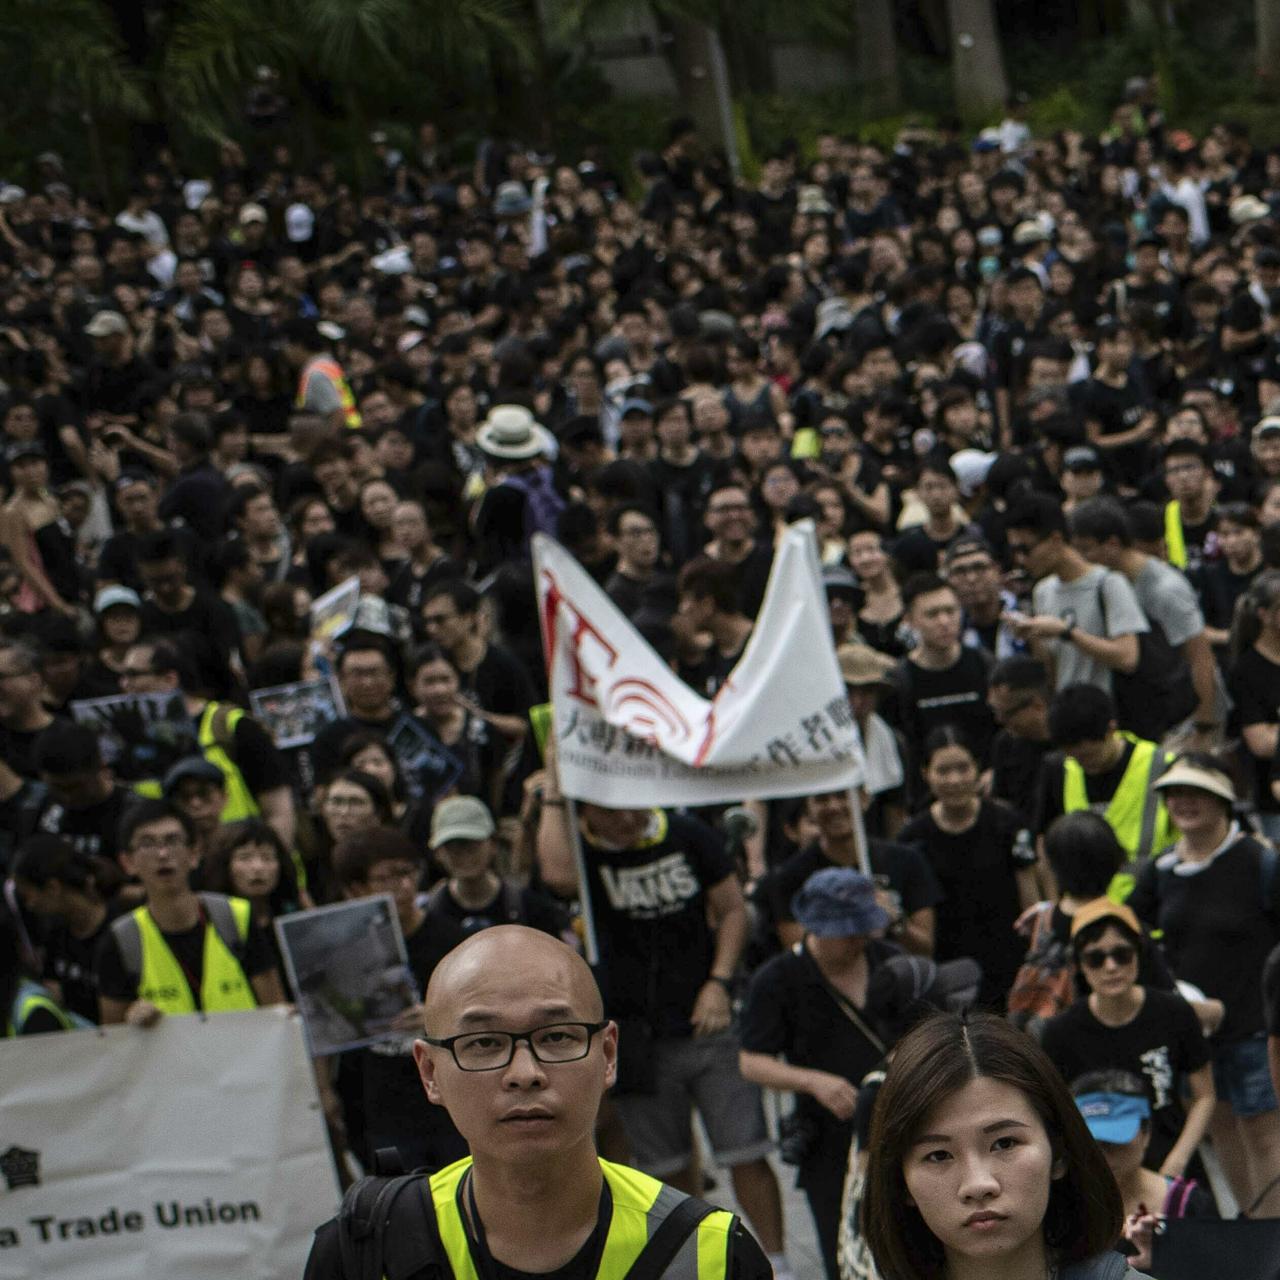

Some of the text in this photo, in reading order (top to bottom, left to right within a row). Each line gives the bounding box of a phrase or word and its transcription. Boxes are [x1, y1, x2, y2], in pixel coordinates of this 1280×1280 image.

[600, 852, 698, 909] VANS
[30, 1206, 144, 1242] Trade
[154, 1197, 261, 1229] Union
